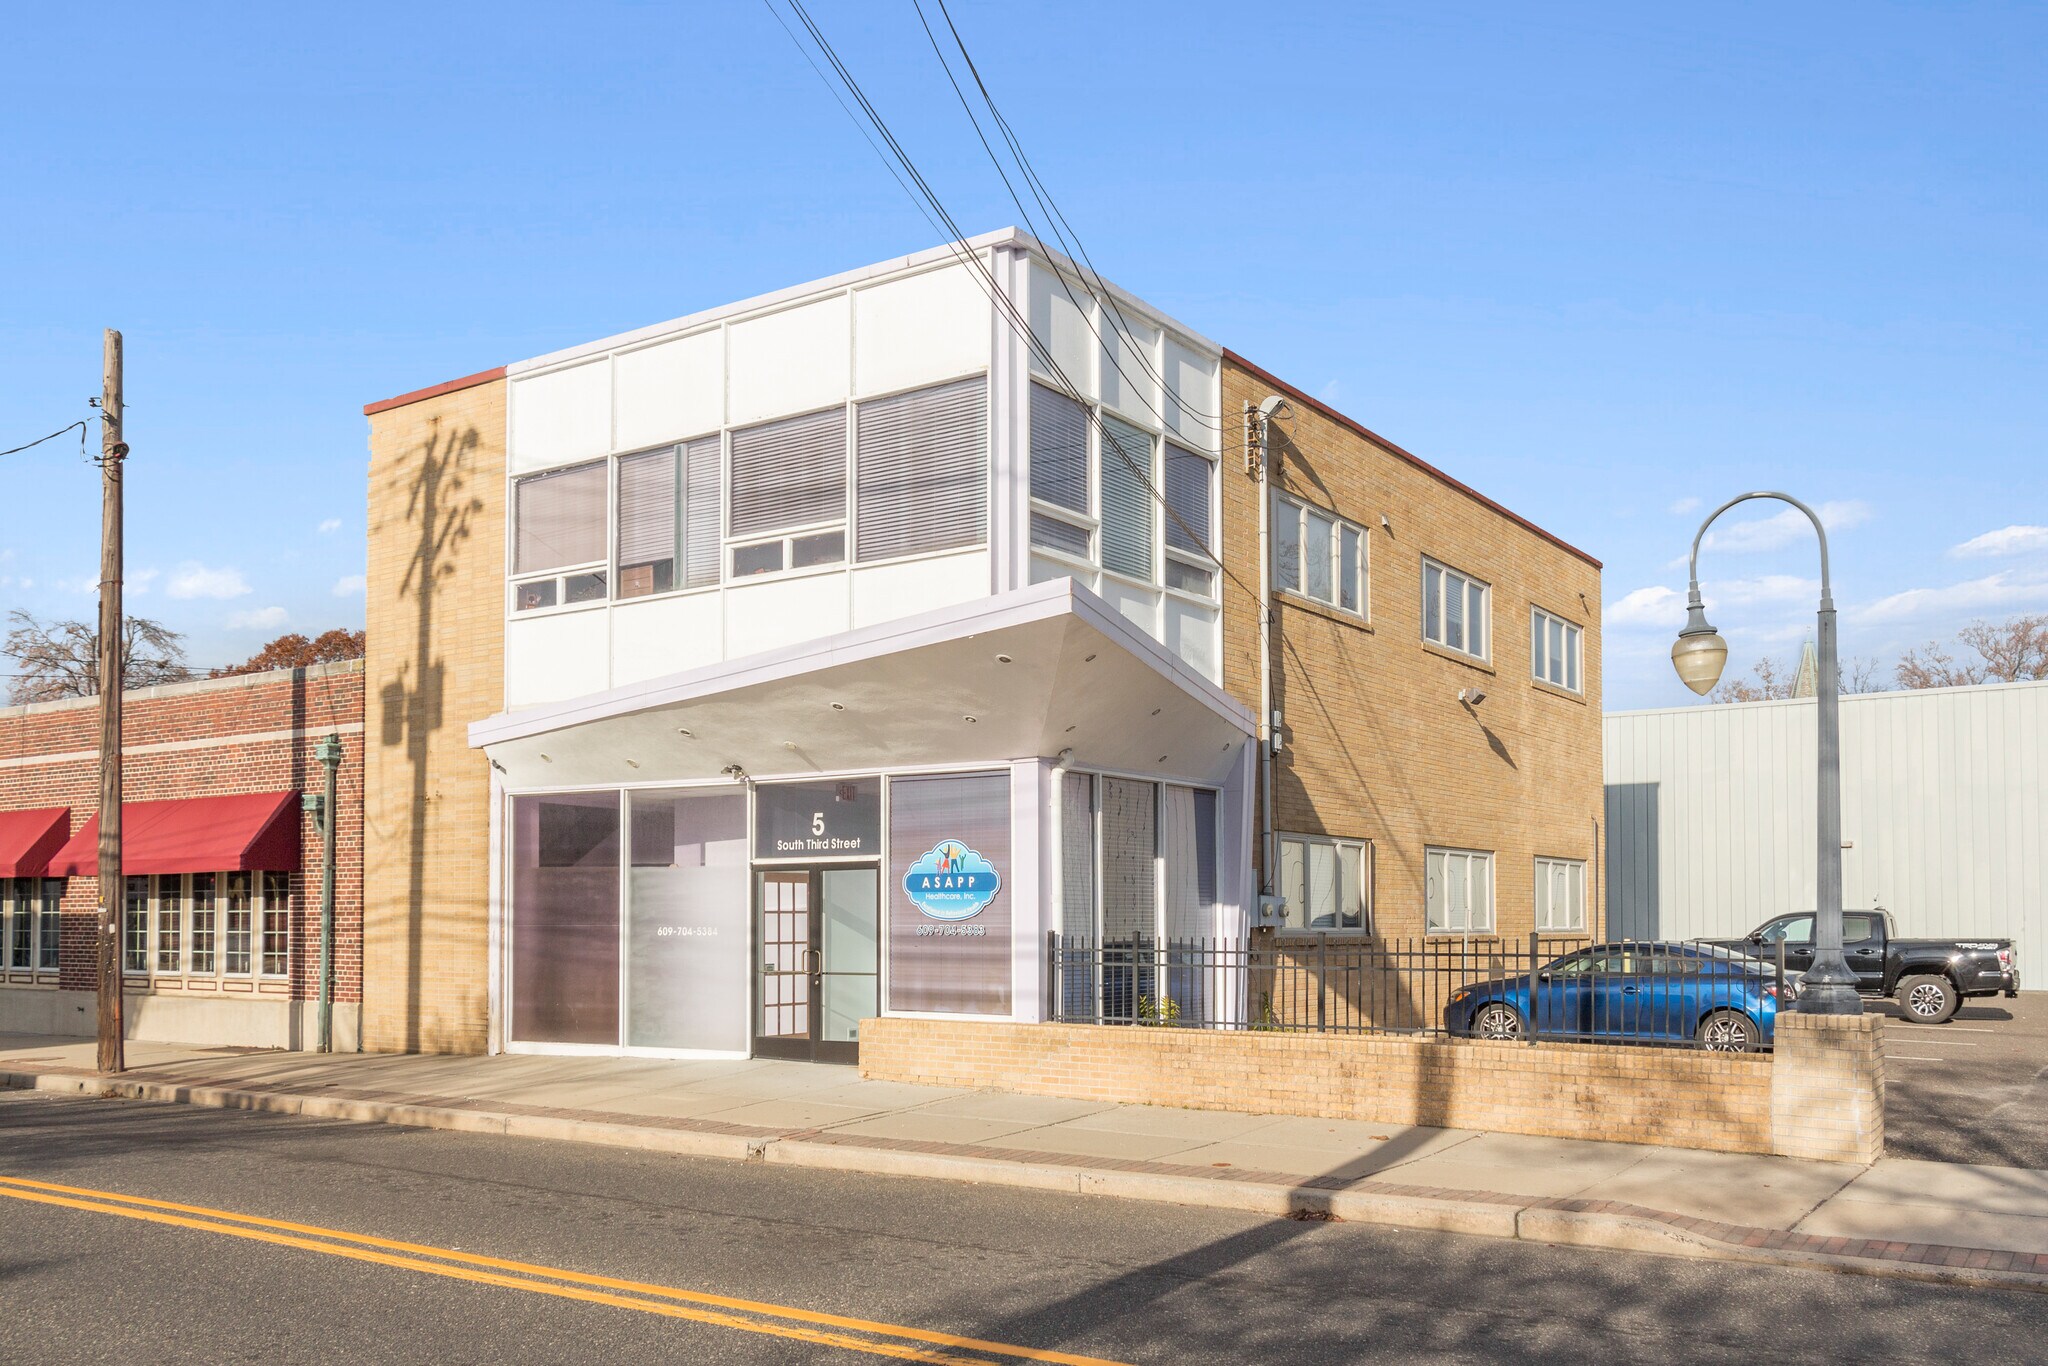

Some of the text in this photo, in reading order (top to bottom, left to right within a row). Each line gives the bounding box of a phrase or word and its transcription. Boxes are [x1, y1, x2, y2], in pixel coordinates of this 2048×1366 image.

[811, 812, 825, 836] 5
[777, 837, 861, 851] South Third Street
[922, 876, 975, 889] ASAPP
[925, 892, 976, 901] Healthcare, Inc.
[657, 926, 718, 936] 609-704-5384
